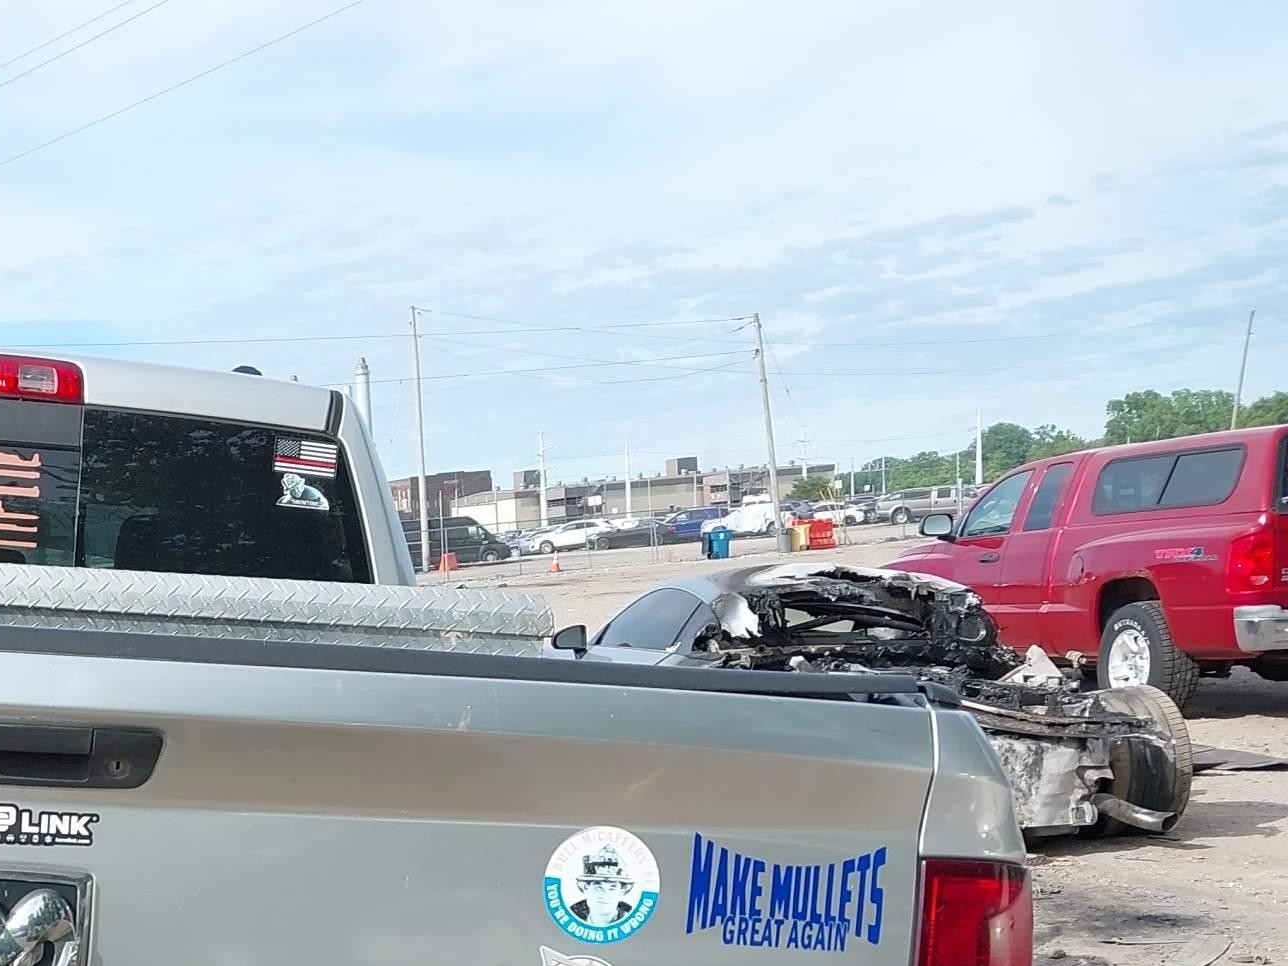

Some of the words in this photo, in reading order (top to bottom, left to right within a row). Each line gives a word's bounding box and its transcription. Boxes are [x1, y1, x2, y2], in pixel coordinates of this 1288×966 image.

[546, 884, 570, 925] YOU'RE
[567, 921, 604, 941] DOING
[607, 928, 619, 940] IT
[620, 898, 654, 934] WRONG
[686, 832, 766, 935] MAKE
[769, 846, 887, 945] MULLETS
[723, 916, 785, 946] GREAT
[787, 921, 849, 952] AGAIN
